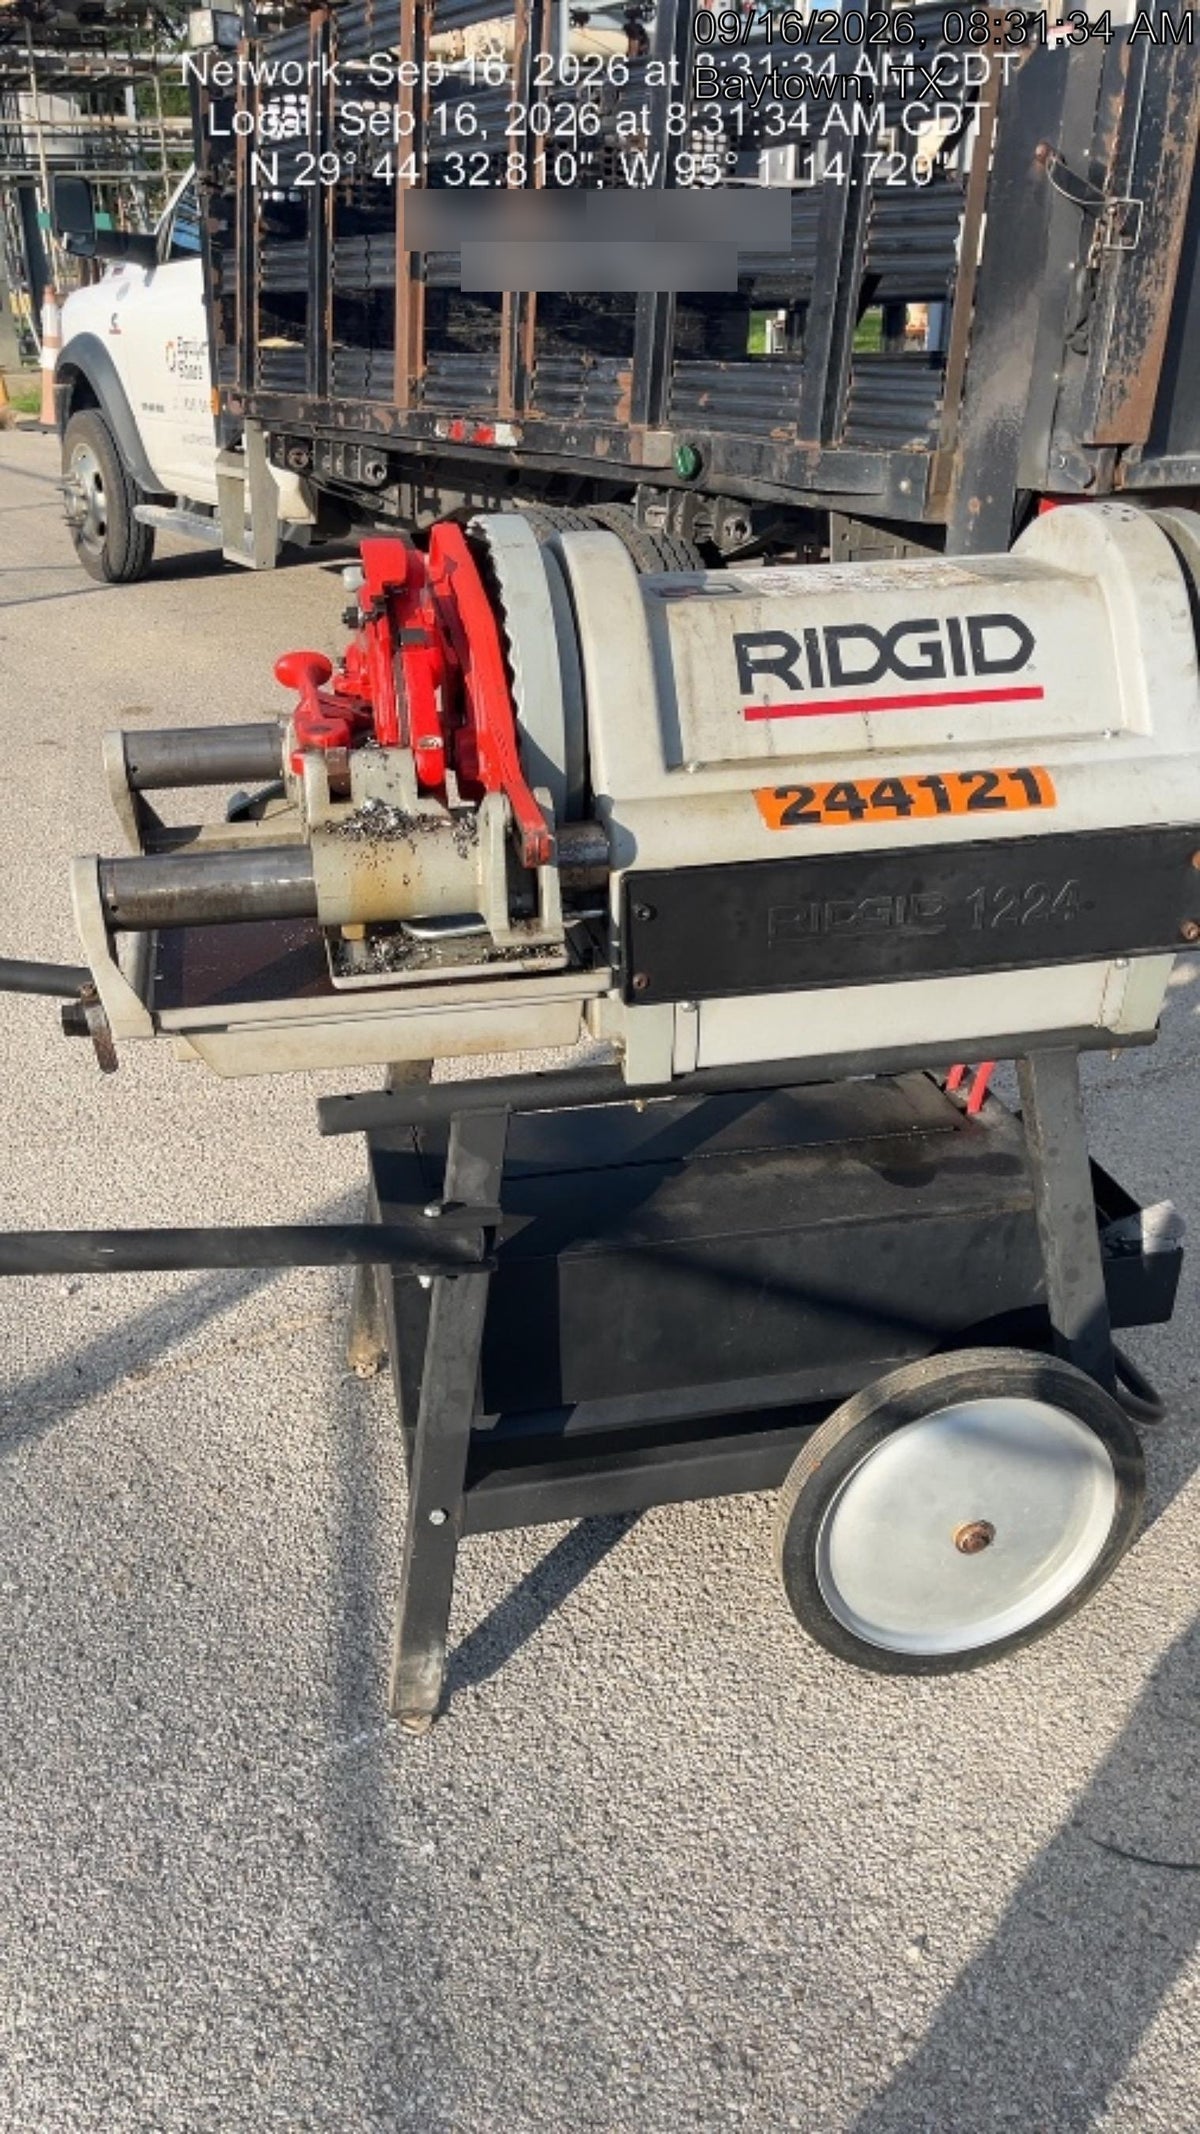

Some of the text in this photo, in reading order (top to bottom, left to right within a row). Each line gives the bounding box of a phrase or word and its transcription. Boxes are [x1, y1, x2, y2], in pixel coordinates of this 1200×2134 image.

[733, 613, 1036, 696] RIDGID
[774, 768, 1042, 827] 244121
[966, 878, 1080, 932] 1224
